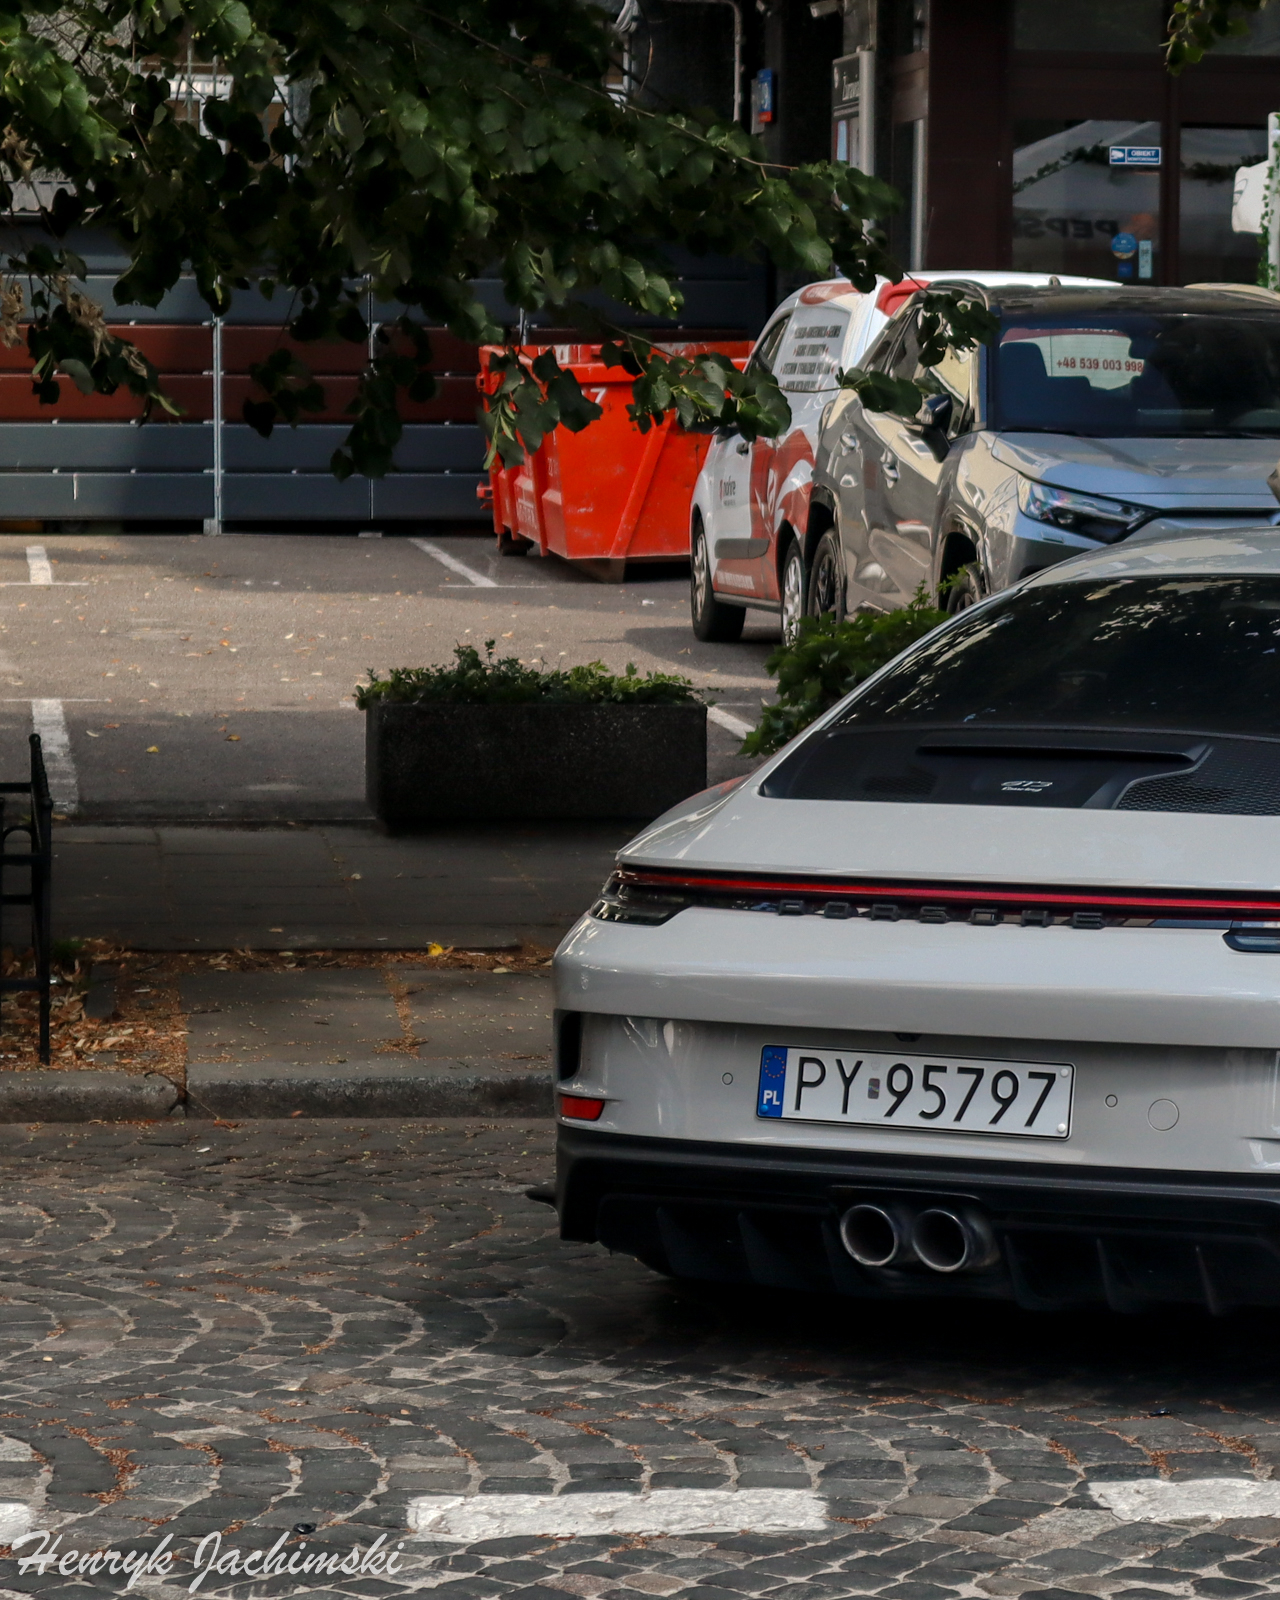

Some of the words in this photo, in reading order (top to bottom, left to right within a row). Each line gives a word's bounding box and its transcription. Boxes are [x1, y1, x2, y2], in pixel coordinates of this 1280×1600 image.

[1056, 356, 1077, 369] +48
[1079, 358, 1100, 370] 539
[1102, 359, 1122, 371] 003
[1124, 361, 1144, 373] 998
[777, 900, 1106, 930] PORSCHE
[762, 1089, 781, 1106] PL
[795, 1056, 864, 1115] PY
[883, 1062, 1058, 1128] 95797
